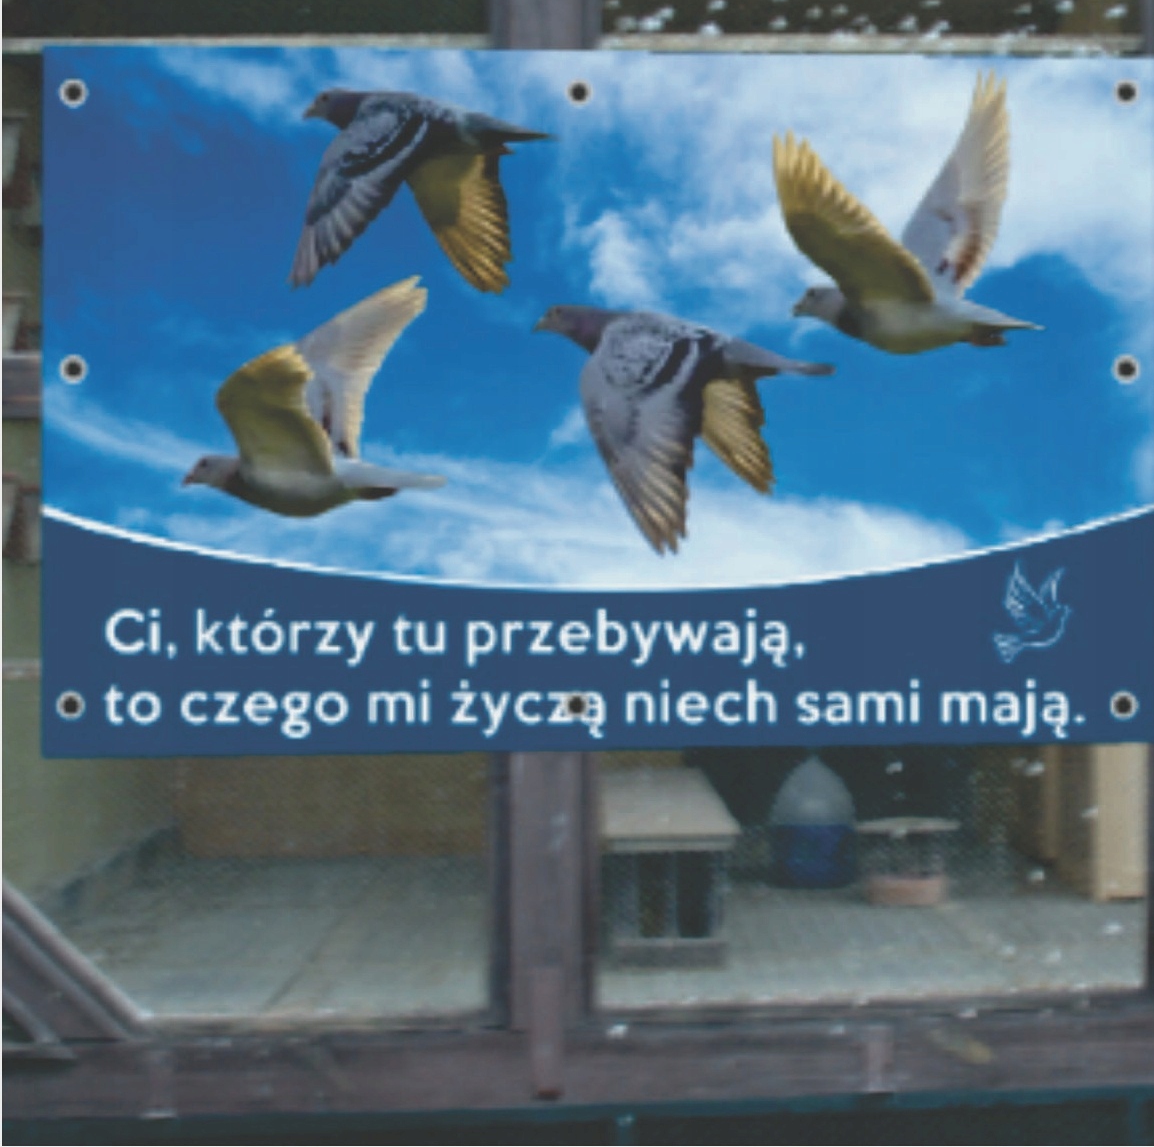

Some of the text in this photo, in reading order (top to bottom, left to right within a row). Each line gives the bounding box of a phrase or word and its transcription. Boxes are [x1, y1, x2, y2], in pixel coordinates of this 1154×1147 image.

[105, 608, 806, 668] Ci, którzy tu przebywają,
[104, 679, 1085, 739] to czego mi życzą niech sami mają.
